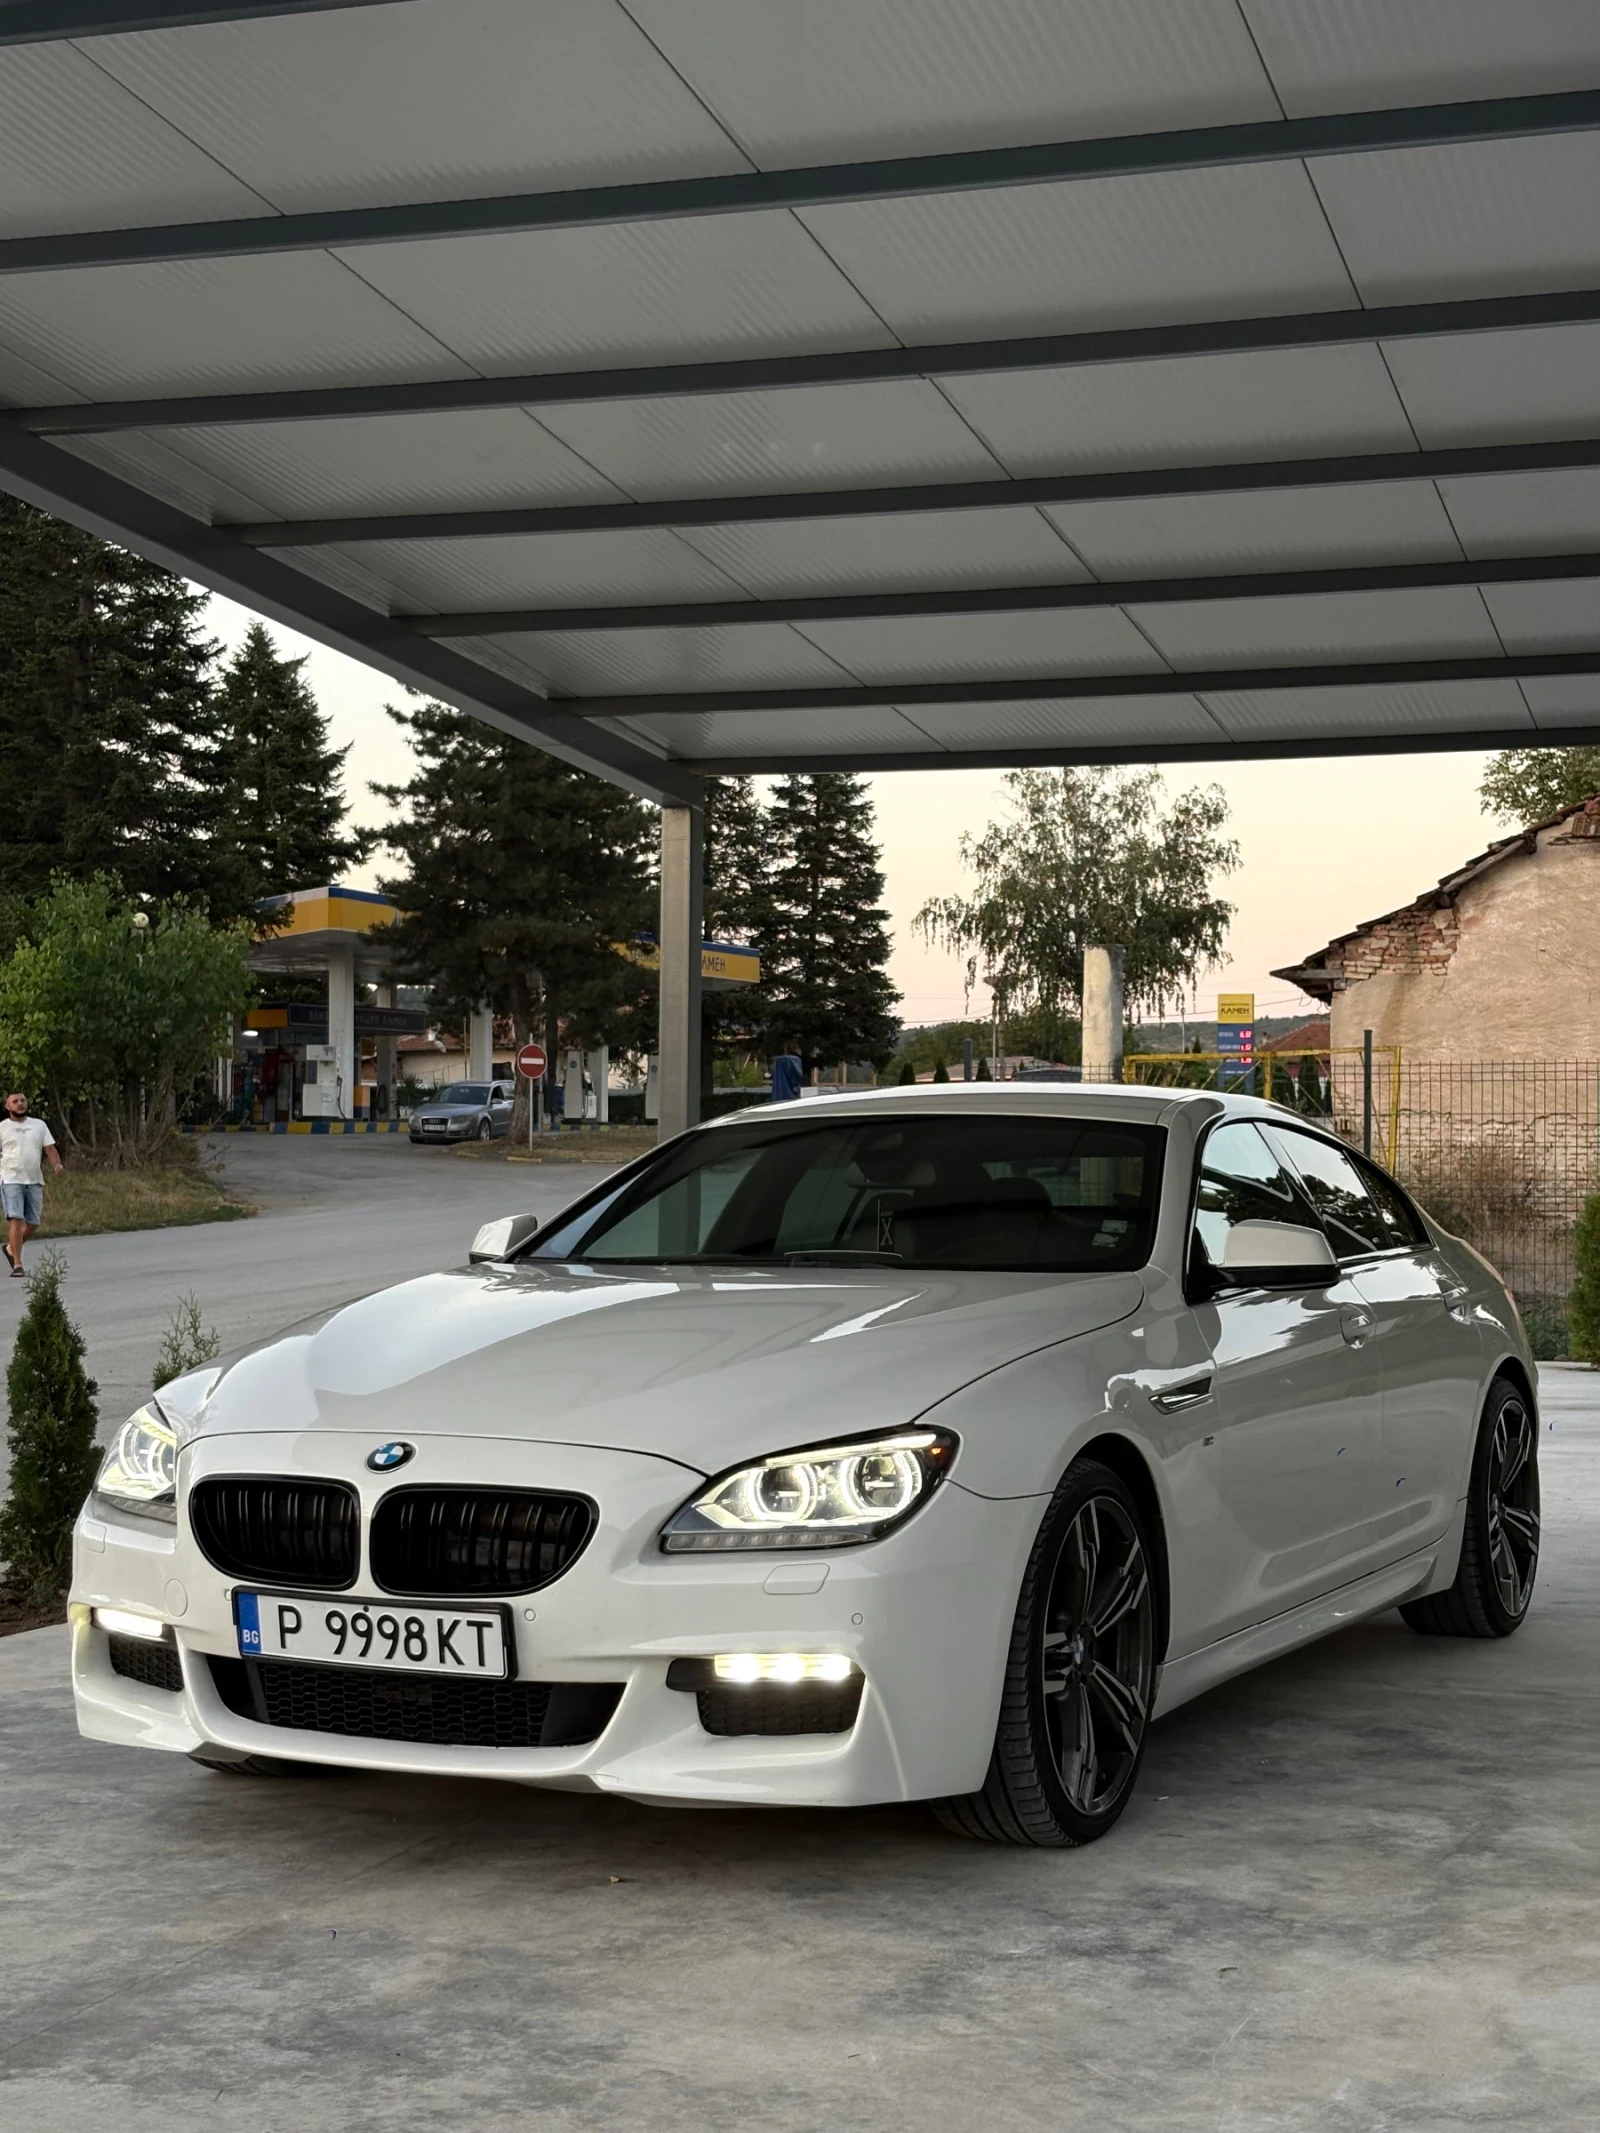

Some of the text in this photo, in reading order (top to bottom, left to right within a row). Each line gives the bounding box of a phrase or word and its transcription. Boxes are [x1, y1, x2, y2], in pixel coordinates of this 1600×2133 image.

[702, 955, 725, 972] АМЕН
[277, 1604, 301, 1649] P
[243, 1628, 259, 1644] BG
